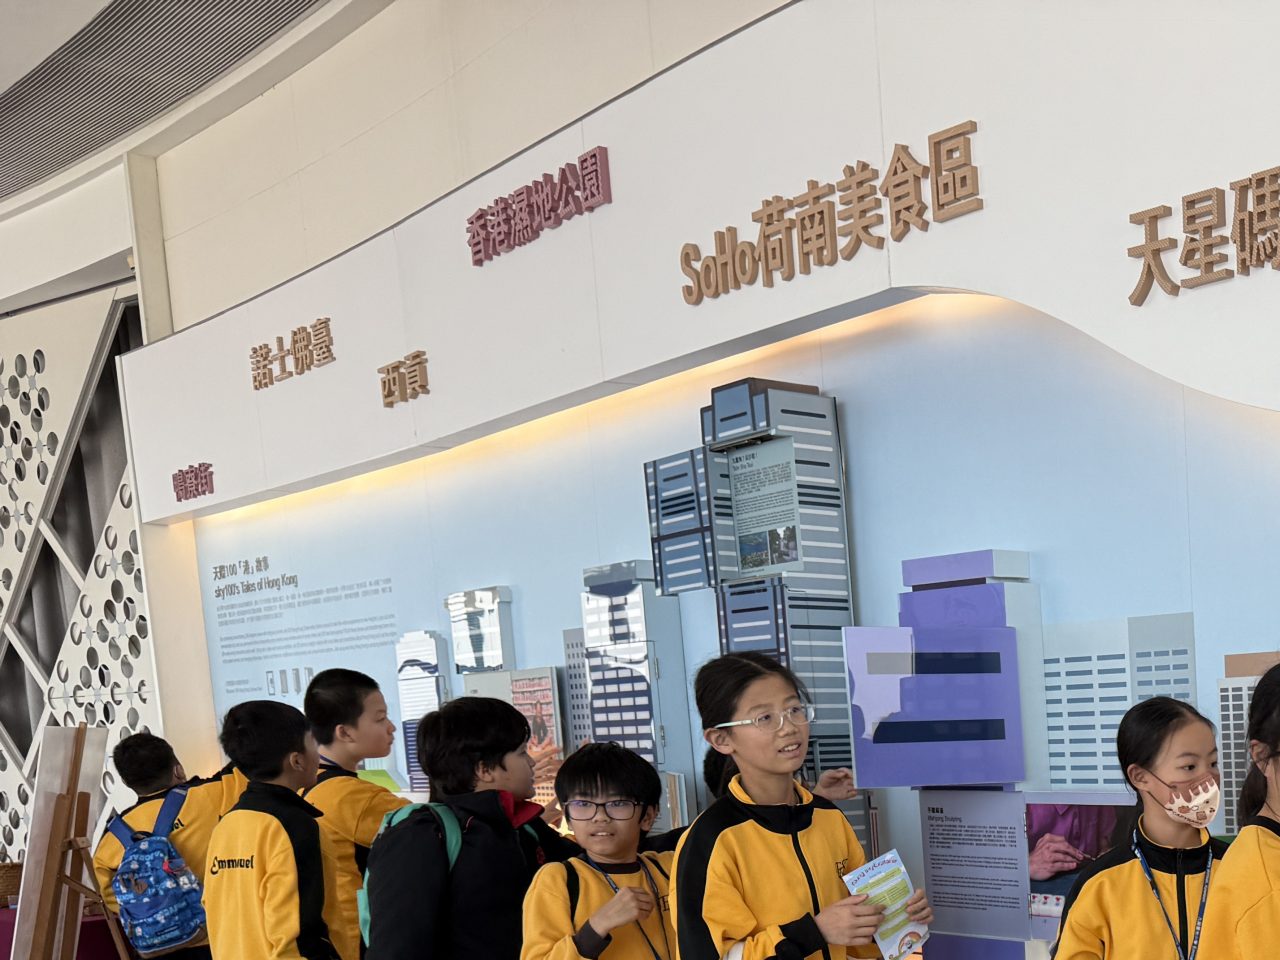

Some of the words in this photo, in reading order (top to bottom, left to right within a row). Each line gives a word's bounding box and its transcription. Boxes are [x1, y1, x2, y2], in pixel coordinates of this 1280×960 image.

[680, 119, 984, 306] SoHo荷南美食區
[250, 317, 336, 391] 諾士佛臺
[377, 350, 430, 408] 西貢
[264, 575, 281, 591] Hong
[282, 573, 299, 588] Kong
